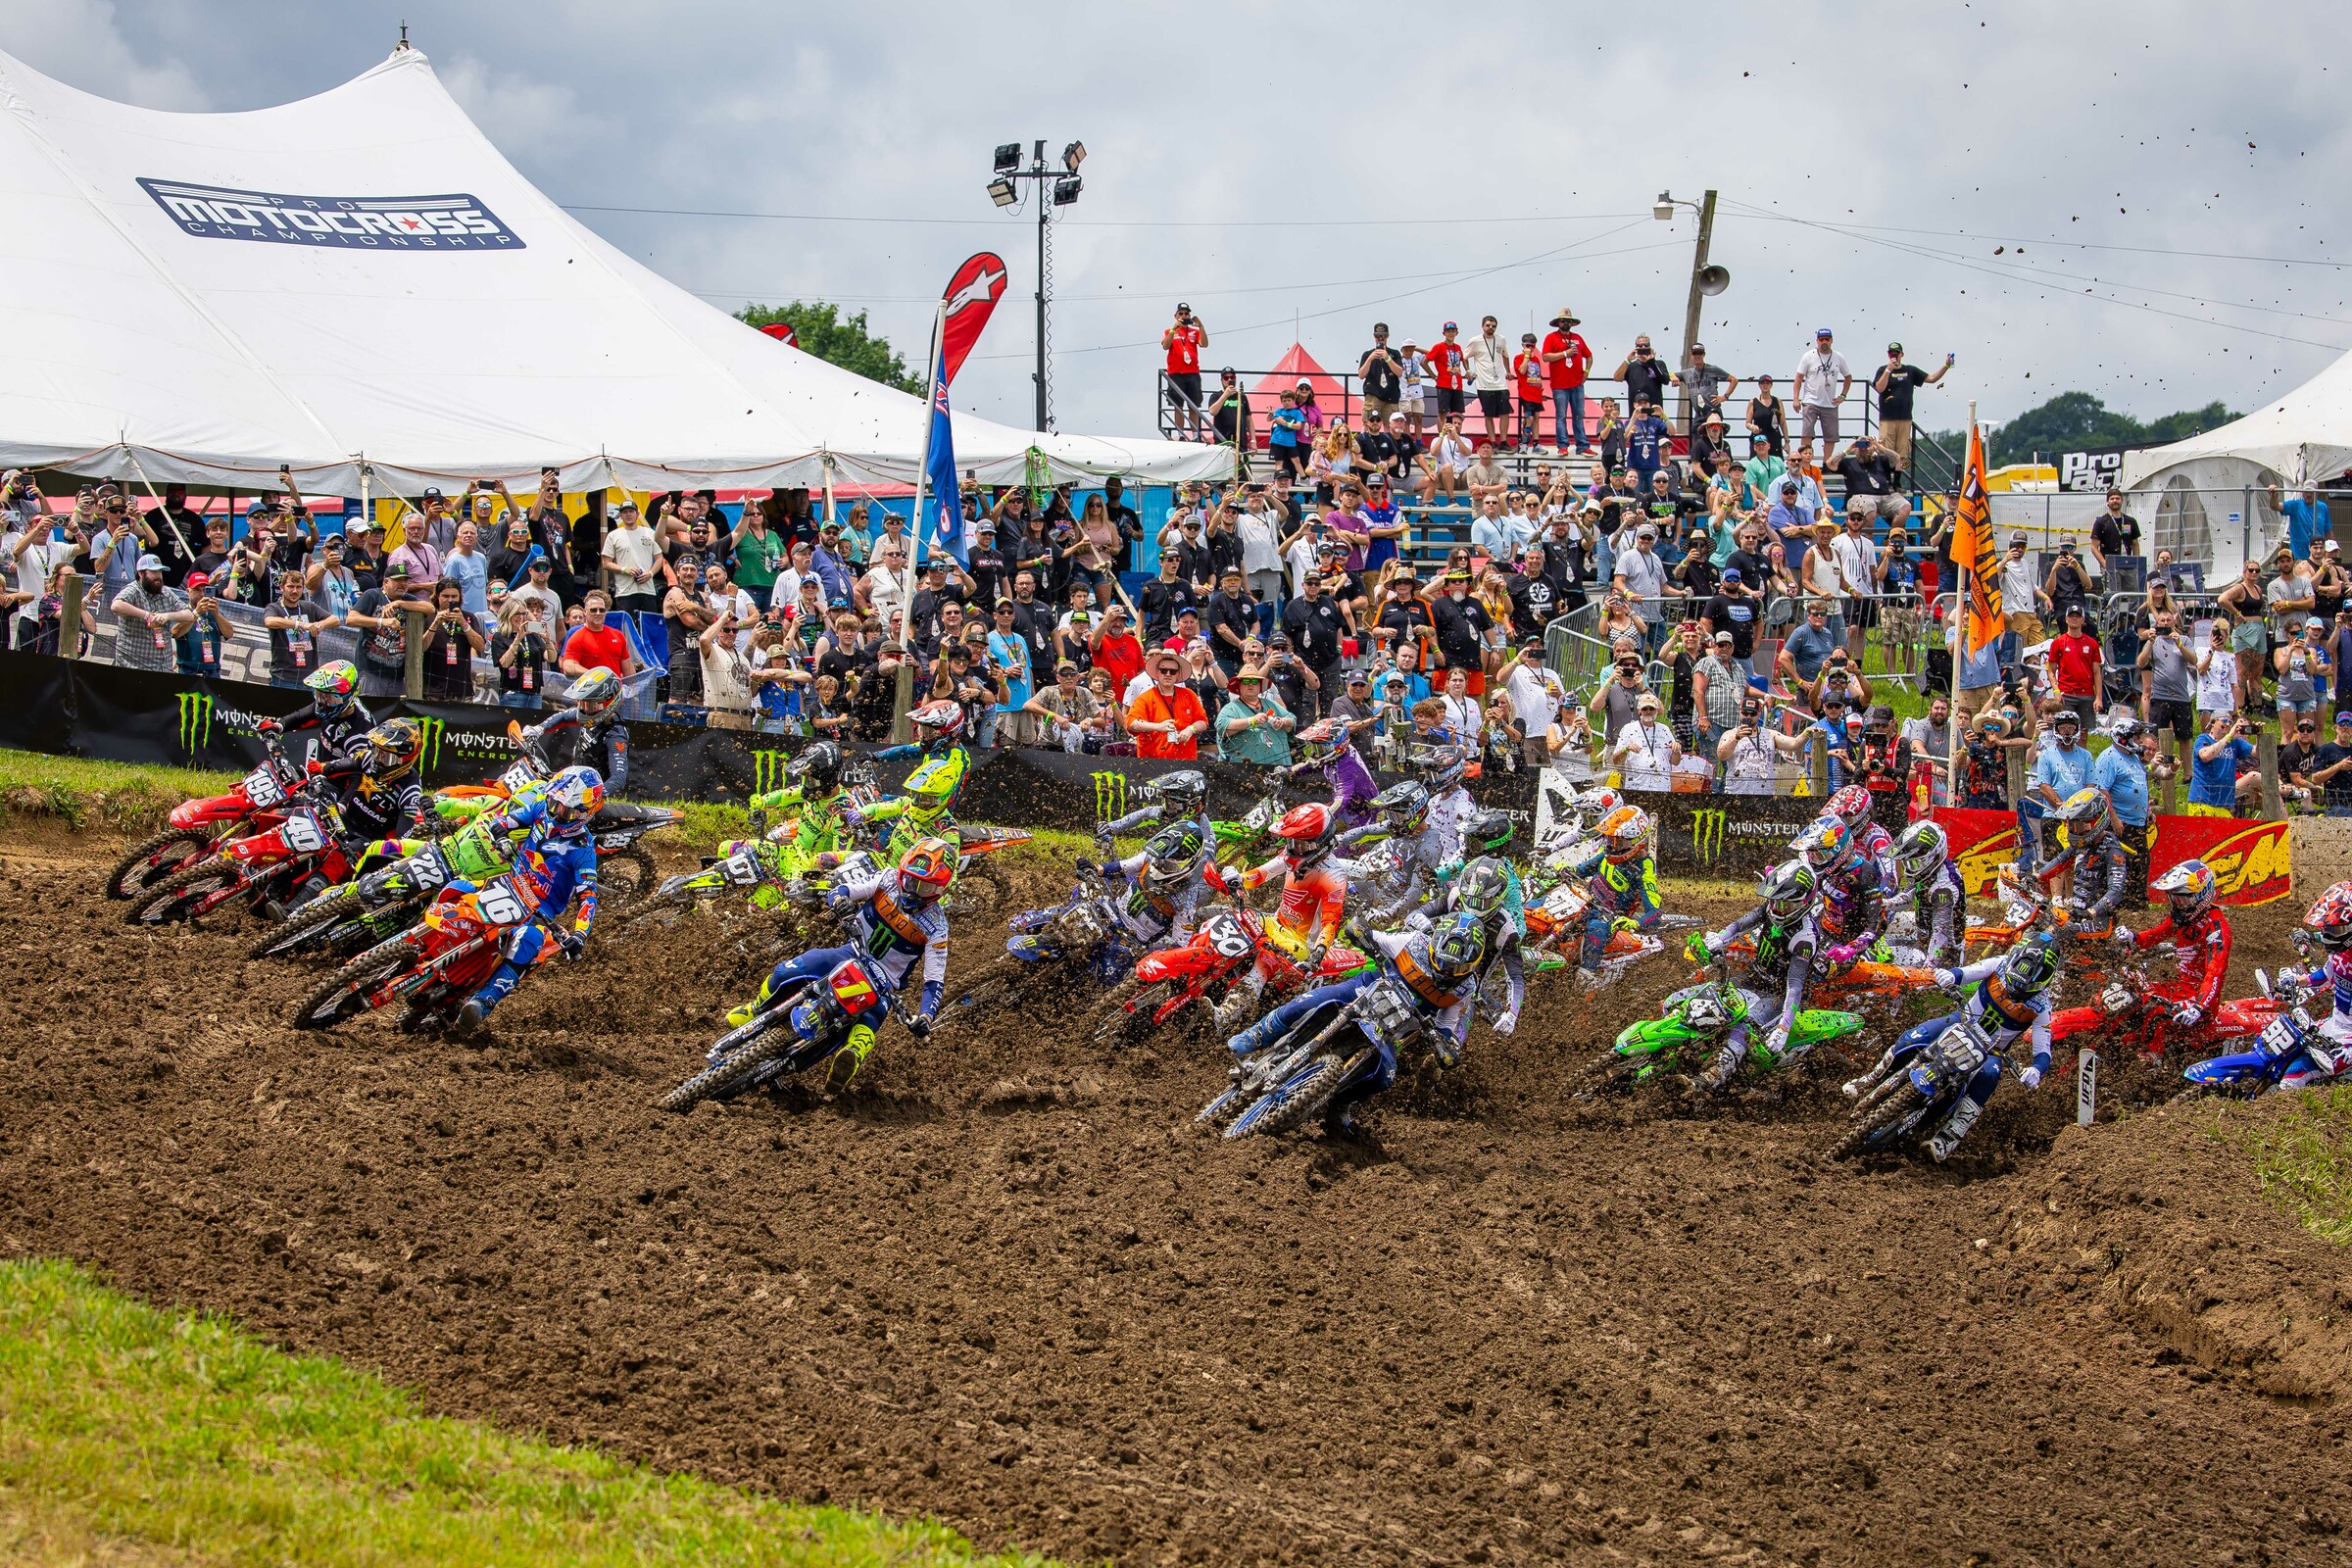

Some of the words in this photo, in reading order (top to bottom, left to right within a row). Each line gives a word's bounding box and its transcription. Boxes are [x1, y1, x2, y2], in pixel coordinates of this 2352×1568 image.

[160, 195, 501, 235] MOTOCROSS
[269, 197, 356, 211] PRO
[185, 221, 511, 246] CHAMPIONSHIP
[2062, 452, 2121, 485] Pro
[457, 749, 518, 761] ENERGY
[244, 767, 284, 808] 195
[370, 794, 395, 811] FLY
[1848, 790, 1866, 815] FXR
[353, 796, 388, 824] GASGAS
[283, 815, 323, 853] 40
[1728, 820, 1800, 835] MONSTER
[408, 852, 445, 891] 22
[478, 880, 522, 924] 16
[1208, 920, 1250, 957] 30
[834, 979, 873, 999] 1
[2261, 1019, 2295, 1056] 92
[753, 1055, 791, 1085] DUNLOP
[2082, 1071, 2092, 1107] UFO
